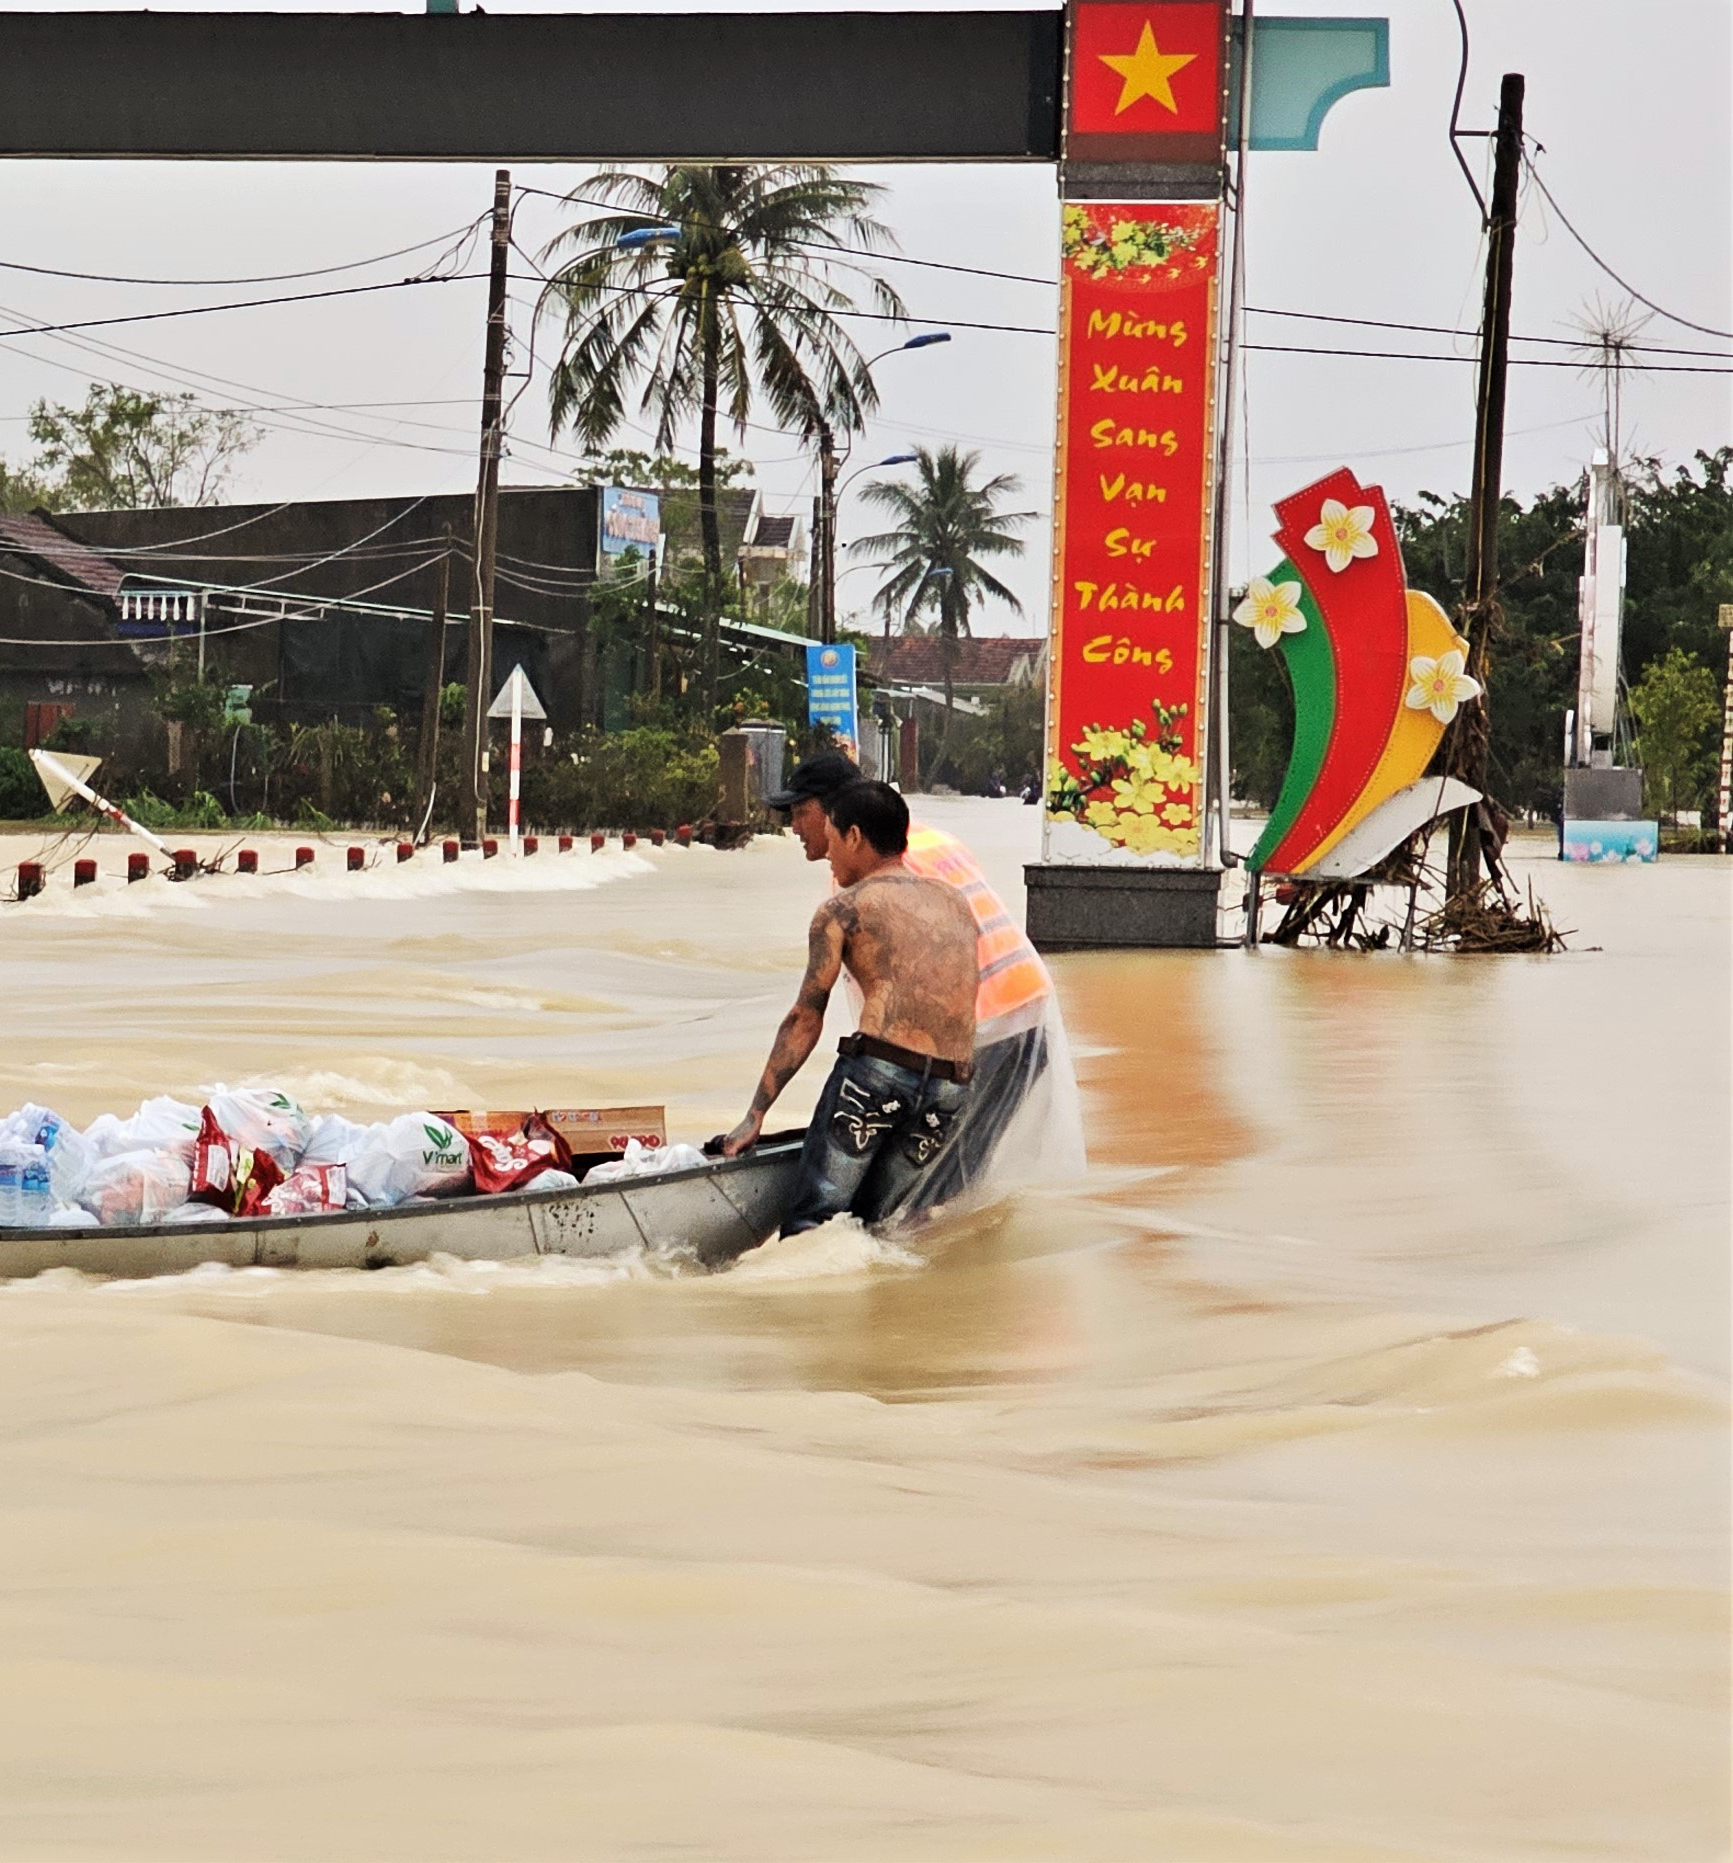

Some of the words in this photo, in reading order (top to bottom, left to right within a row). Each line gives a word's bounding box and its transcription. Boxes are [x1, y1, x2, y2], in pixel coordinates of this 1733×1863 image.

[1087, 309, 1188, 347] Mừng
[1089, 363, 1183, 394] Xuân
[1090, 418, 1178, 457] Sang
[1100, 472, 1167, 508] Vạn
[1104, 527, 1157, 564] Sự
[1074, 581, 1185, 613] Thành
[1082, 635, 1173, 675] Công
